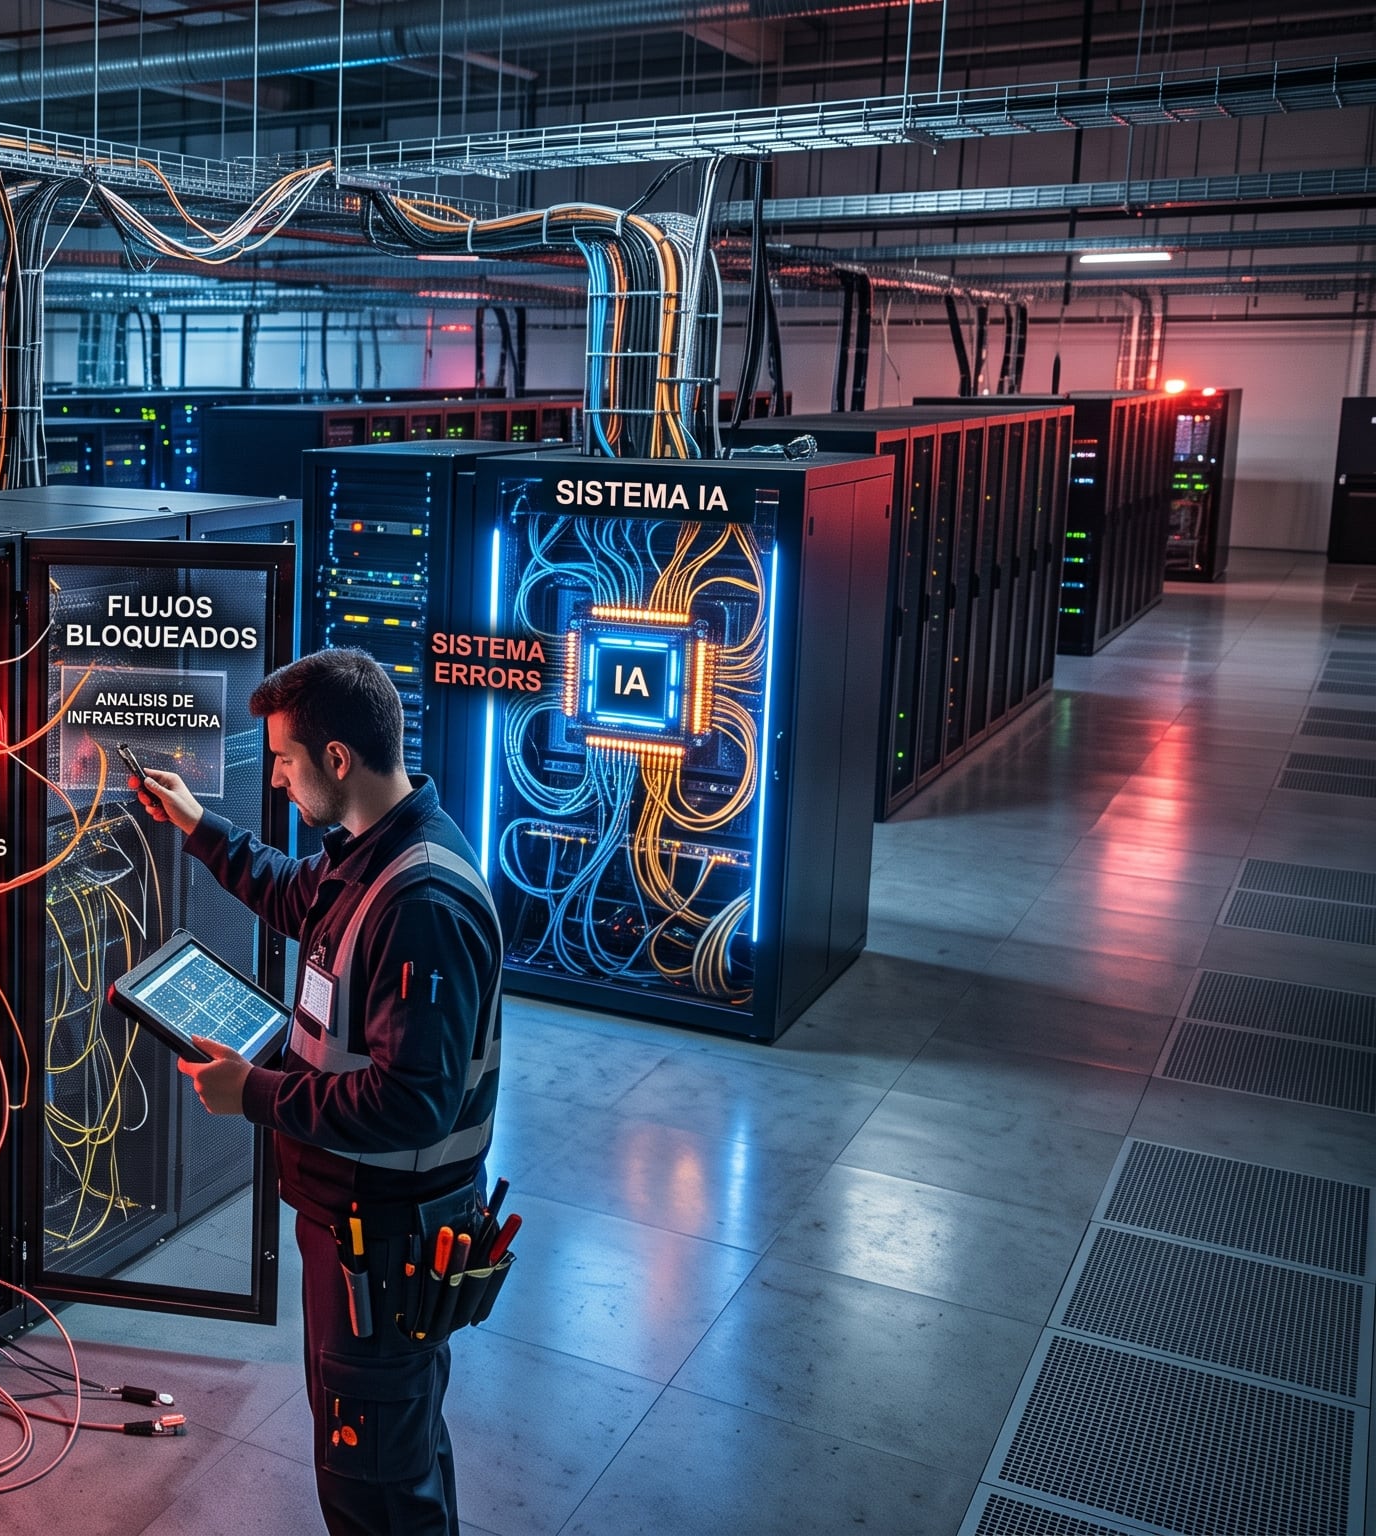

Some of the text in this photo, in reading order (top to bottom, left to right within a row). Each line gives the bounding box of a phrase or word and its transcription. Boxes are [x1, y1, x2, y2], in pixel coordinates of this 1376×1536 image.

[555, 479, 729, 512] SISTEMA IA
[107, 595, 213, 618] FLUJOS
[66, 624, 258, 649] BLOQUEADOS
[431, 632, 546, 663] SISTEMA
[434, 661, 542, 692] ERRORS
[614, 664, 649, 697] IA
[95, 692, 194, 708] ANALISIS DE
[67, 710, 221, 728] INFRAESTRUCTURA
